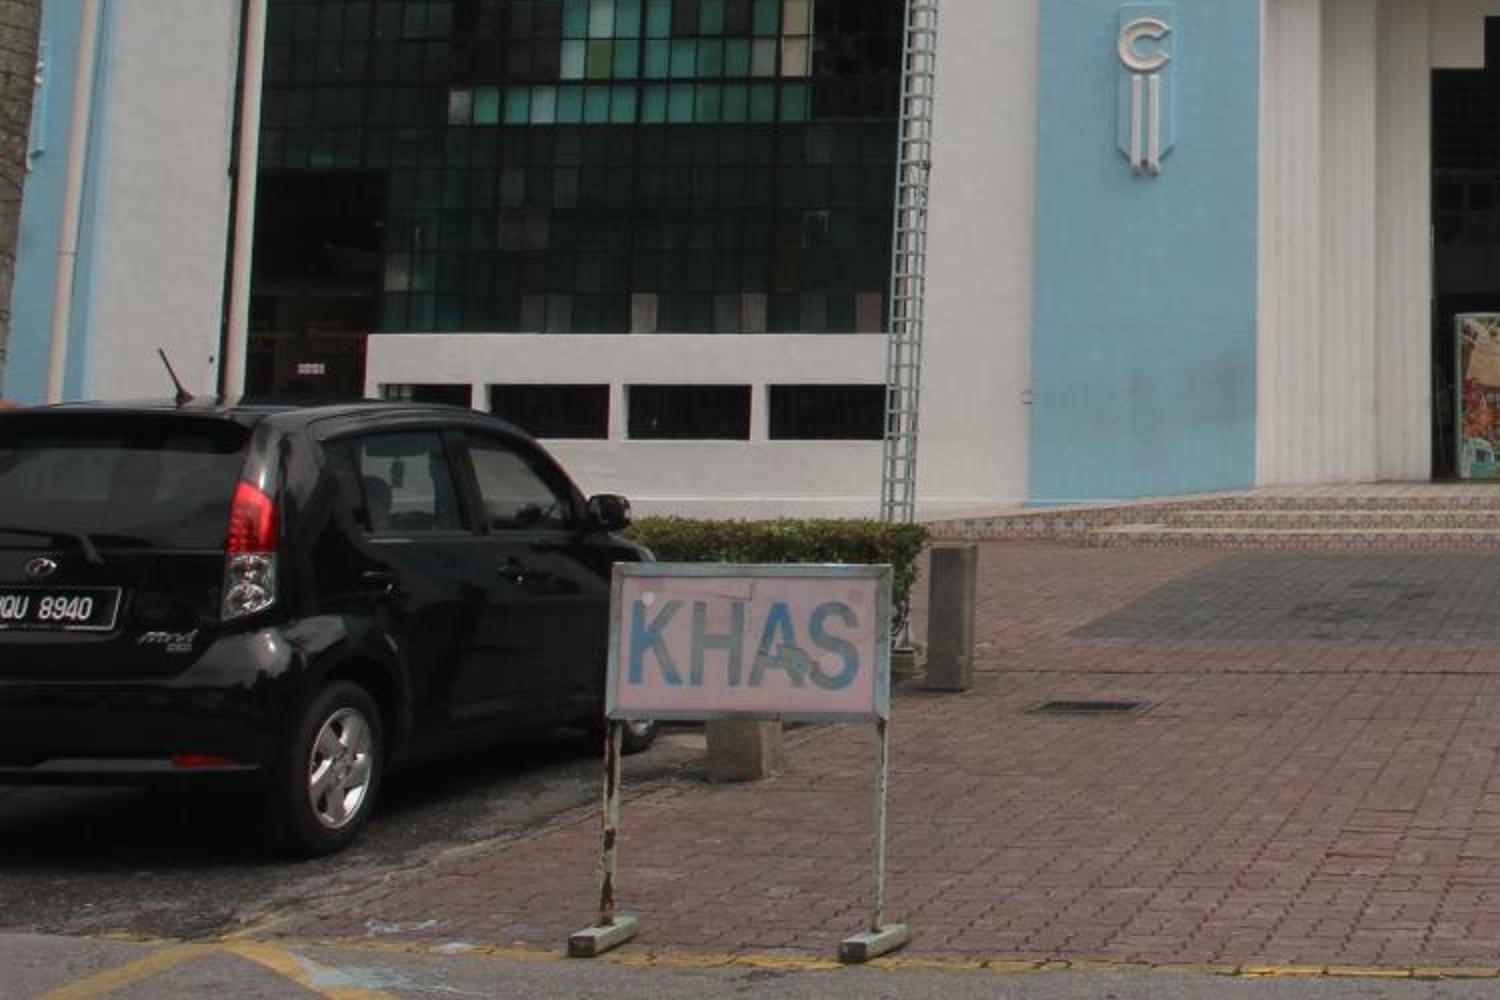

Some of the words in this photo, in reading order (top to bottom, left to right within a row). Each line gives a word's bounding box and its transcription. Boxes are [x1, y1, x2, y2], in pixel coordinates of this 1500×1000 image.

[0, 595, 29, 619] QU
[38, 597, 93, 620] 8940
[627, 600, 860, 690] KHAS
